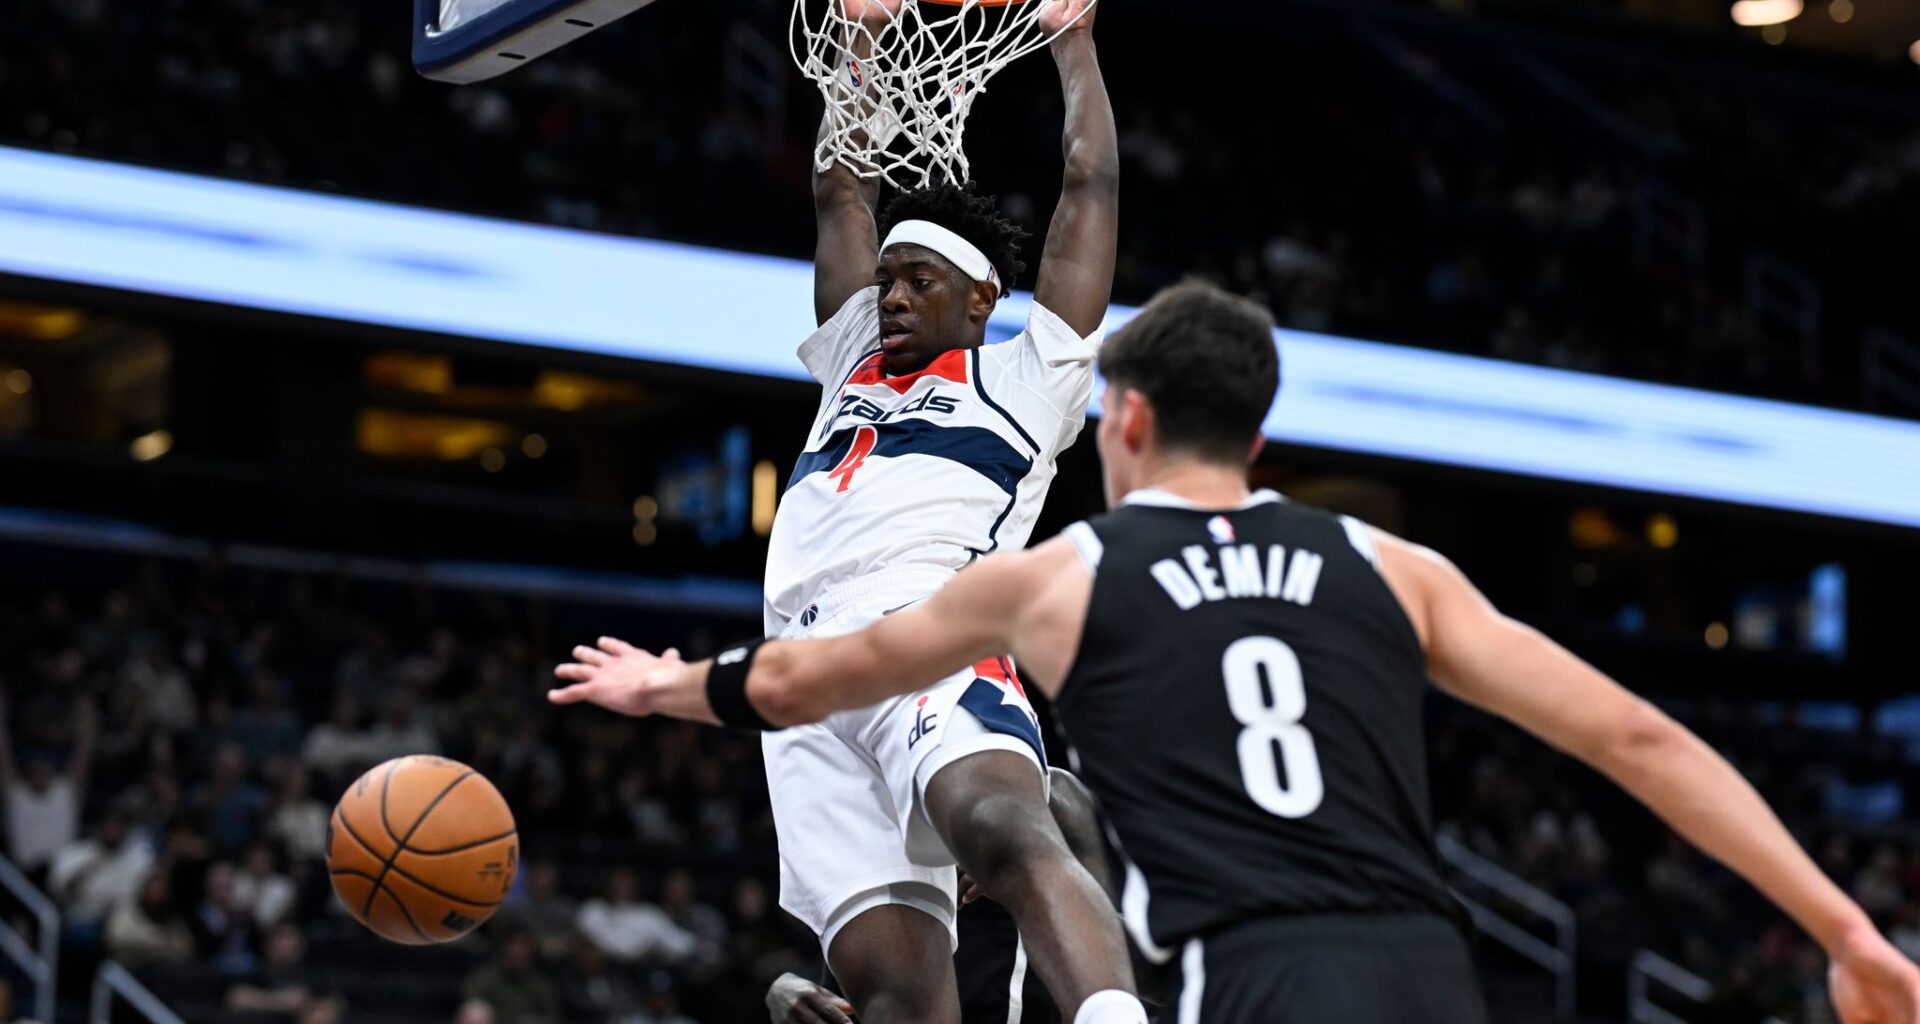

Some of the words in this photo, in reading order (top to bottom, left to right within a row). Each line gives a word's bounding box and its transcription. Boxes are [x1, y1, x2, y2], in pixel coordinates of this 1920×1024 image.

[827, 425, 877, 494] 4
[1150, 544, 1324, 610] DEMIN
[1222, 635, 1324, 819] 8
